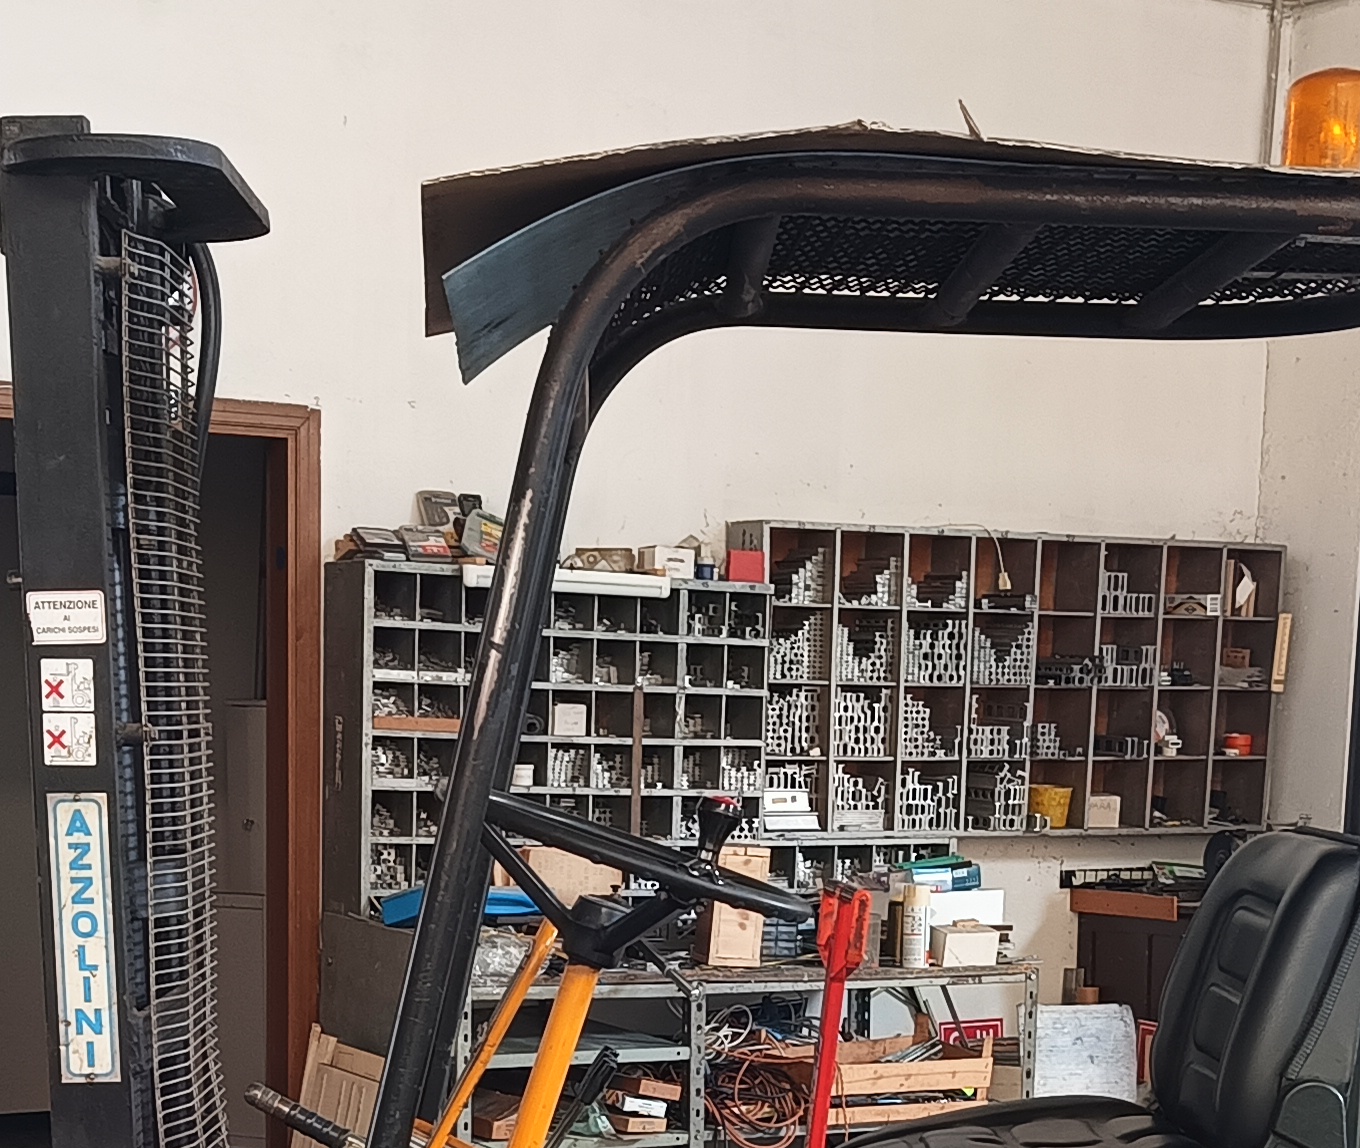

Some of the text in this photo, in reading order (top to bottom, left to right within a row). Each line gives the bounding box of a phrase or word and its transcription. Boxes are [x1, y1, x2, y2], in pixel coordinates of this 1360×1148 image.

[34, 600, 99, 610] ATTENZIONE
[68, 626, 99, 634] SOSPESI
[65, 808, 103, 1068] AZZOLINI
